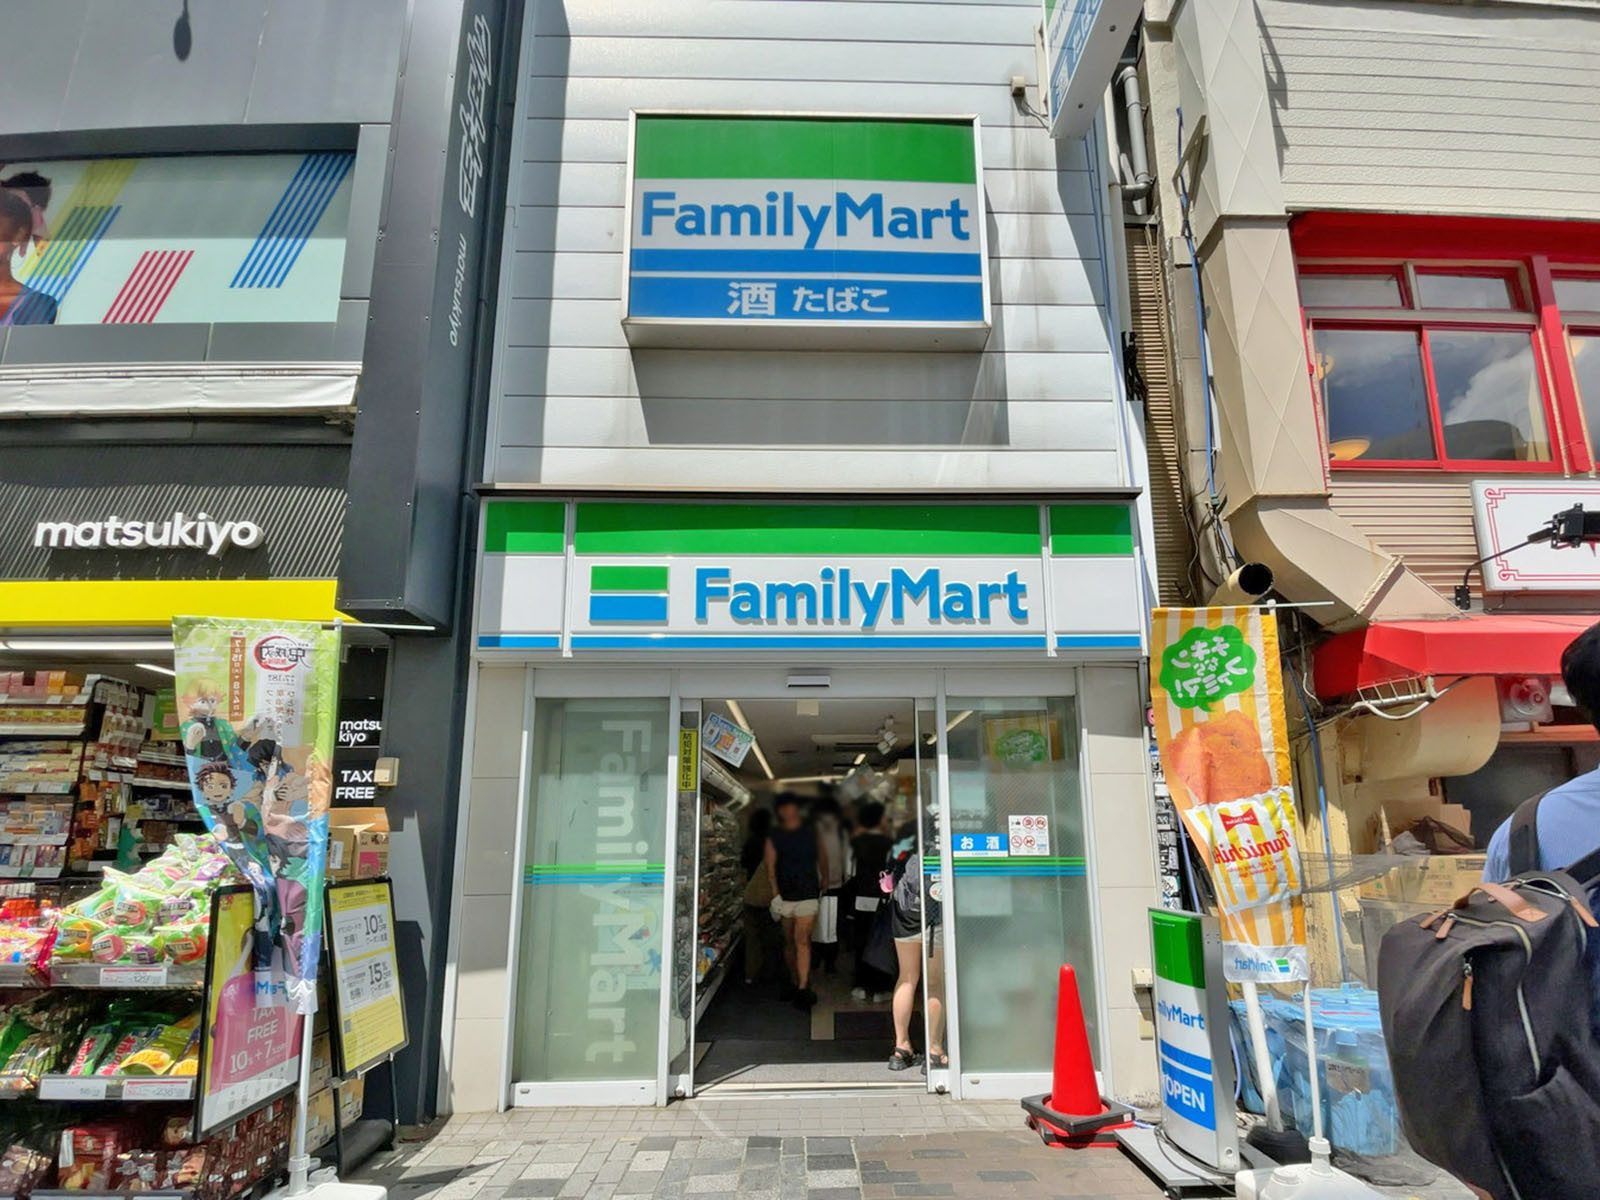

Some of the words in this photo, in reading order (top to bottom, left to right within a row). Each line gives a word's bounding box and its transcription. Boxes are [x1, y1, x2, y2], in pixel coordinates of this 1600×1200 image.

[641, 191, 970, 249] FamilyMart
[450, 233, 467, 346] matsukiyo
[727, 282, 777, 316] 酒
[793, 286, 890, 313] たばこ
[34, 512, 260, 556] matsukiyo
[695, 567, 1028, 630] FamilyMart
[339, 730, 366, 748] kiyo
[336, 786, 375, 800] FREE
[341, 770, 373, 783] TAX
[585, 720, 651, 1062] FamilyMart
[247, 1019, 280, 1043] FREE
